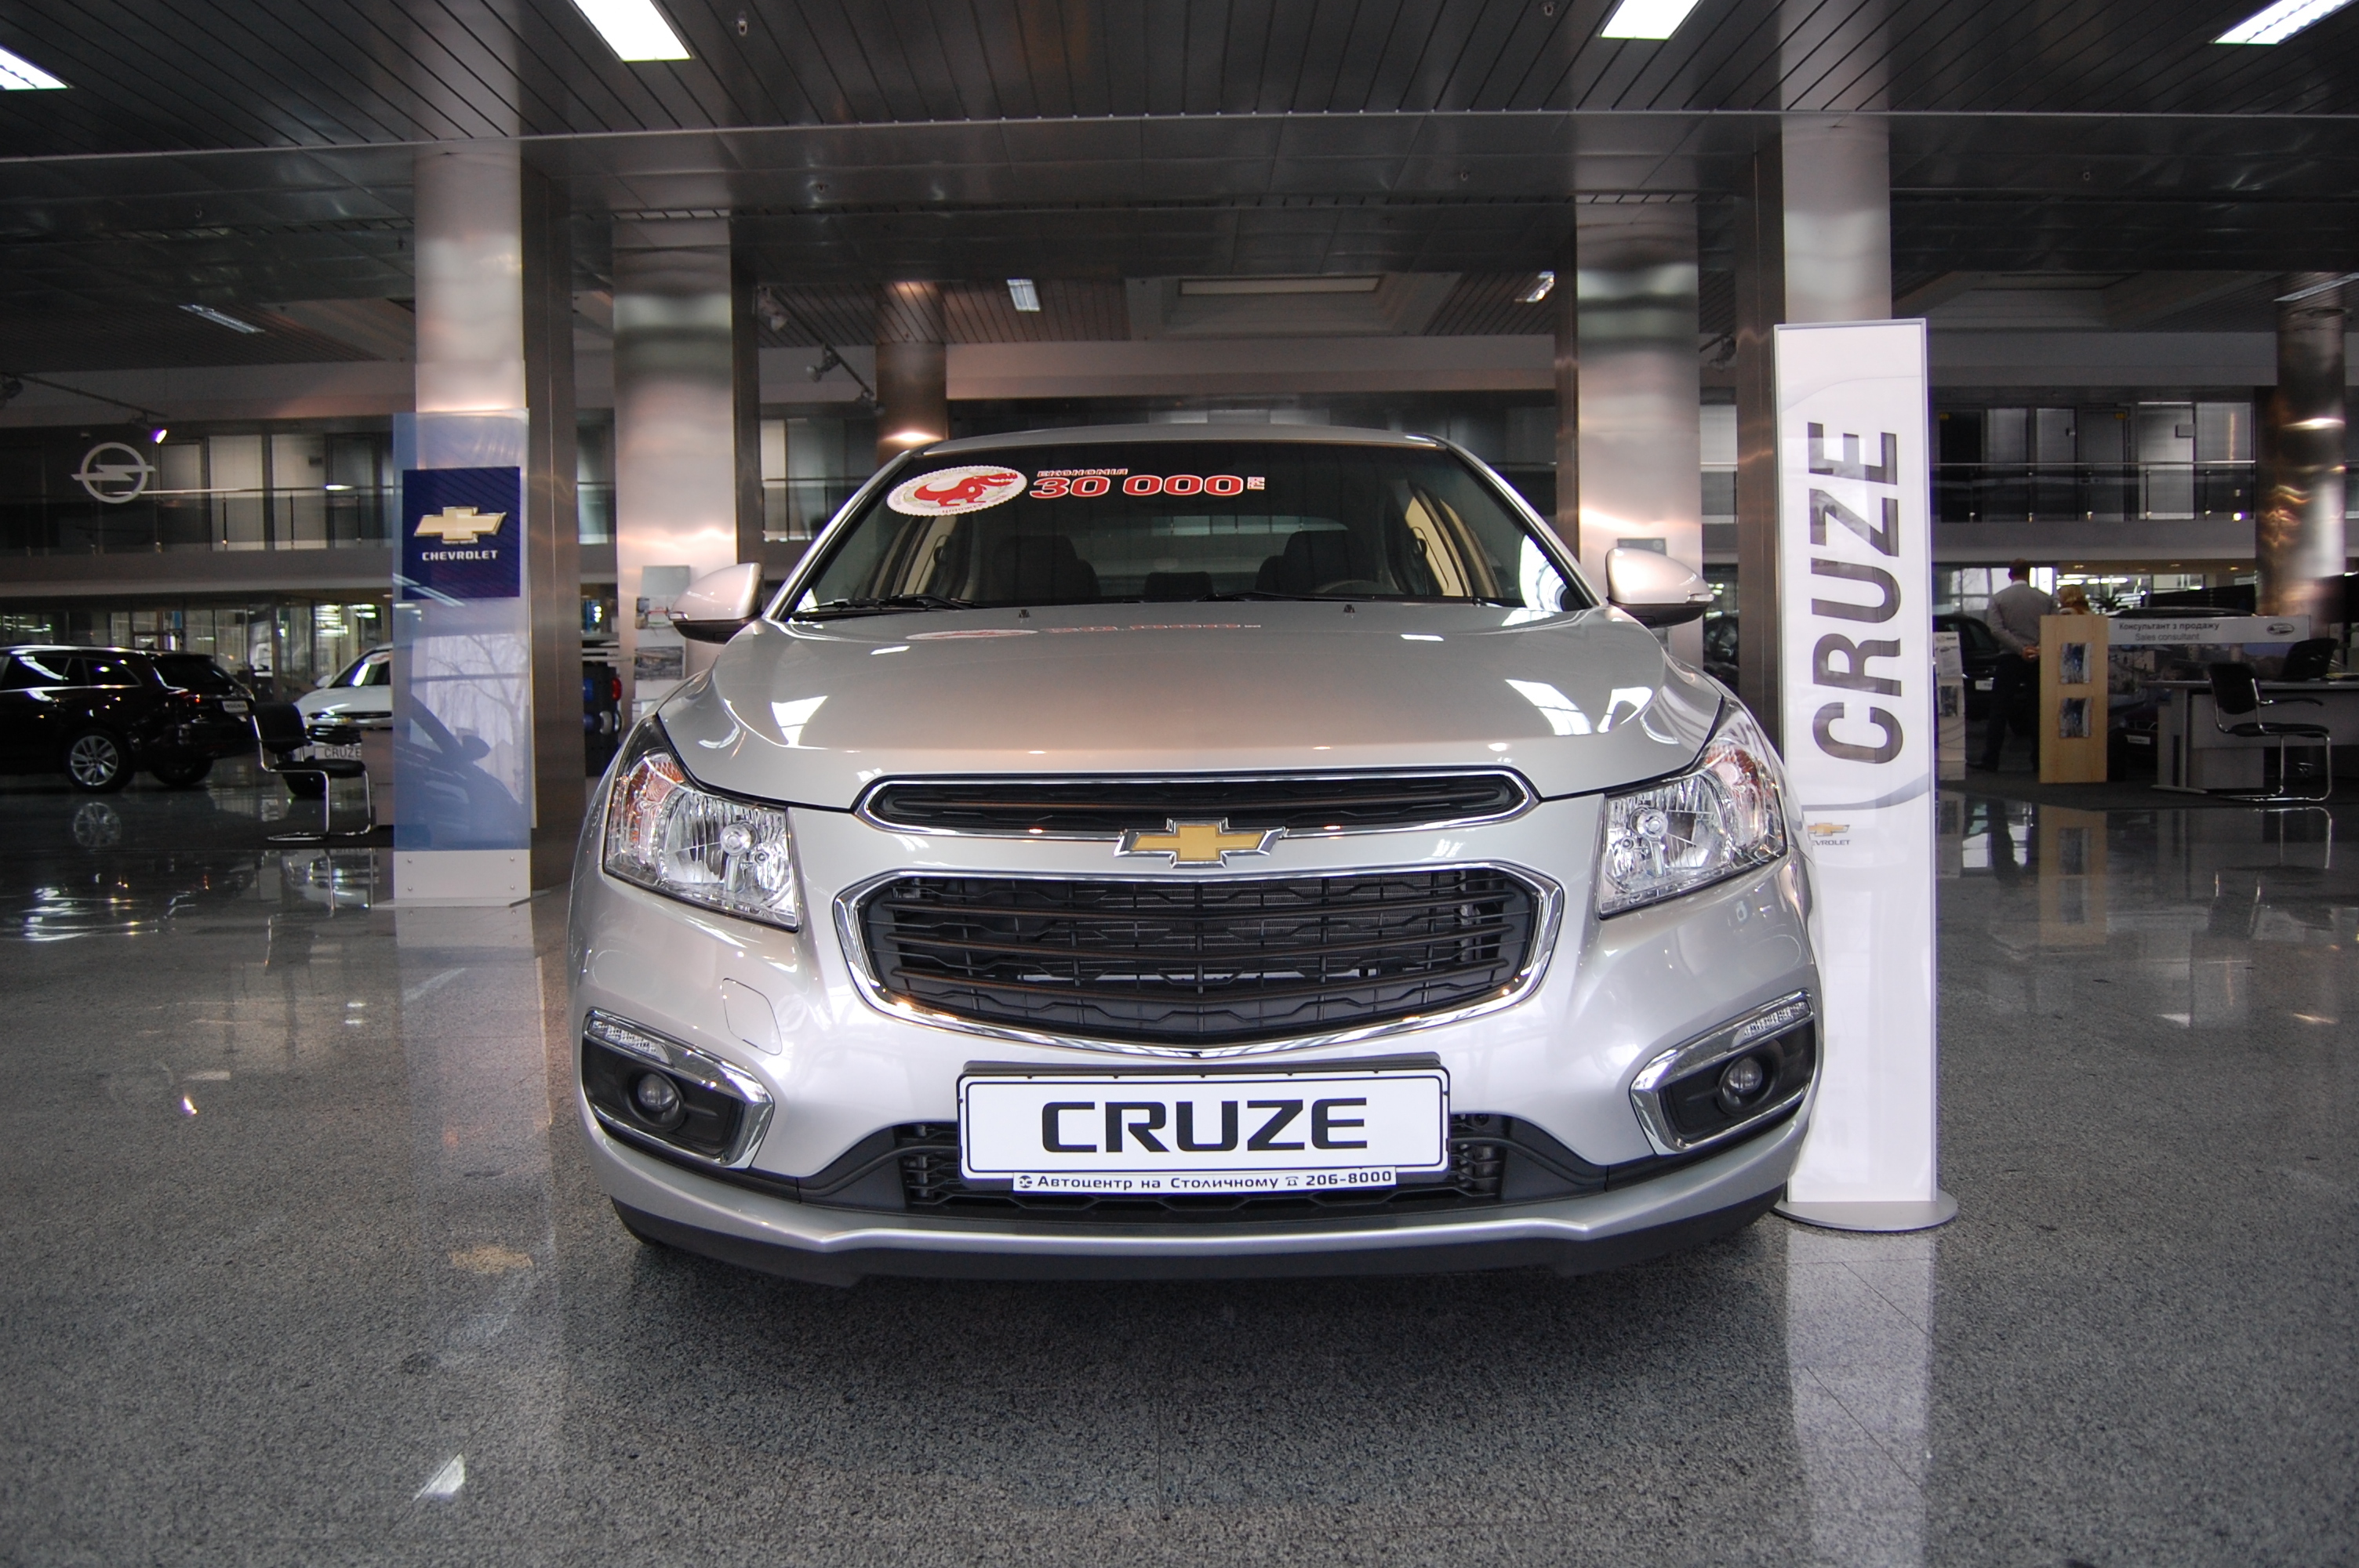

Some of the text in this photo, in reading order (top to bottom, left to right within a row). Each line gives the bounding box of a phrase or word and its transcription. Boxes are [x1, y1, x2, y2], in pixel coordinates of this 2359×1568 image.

[1029, 475, 1111, 499] 30
[1122, 474, 1244, 496] 000
[422, 550, 498, 561] CHEVROLET
[1807, 421, 1904, 764] CRUZE
[2119, 622, 2170, 631] Консультант
[2179, 622, 2220, 631] продажу
[324, 746, 362, 758] CRUZE
[1041, 1097, 1368, 1152] CRUZE
[1037, 1171, 1392, 1190] Автоцентр на Столичному 206-8000
